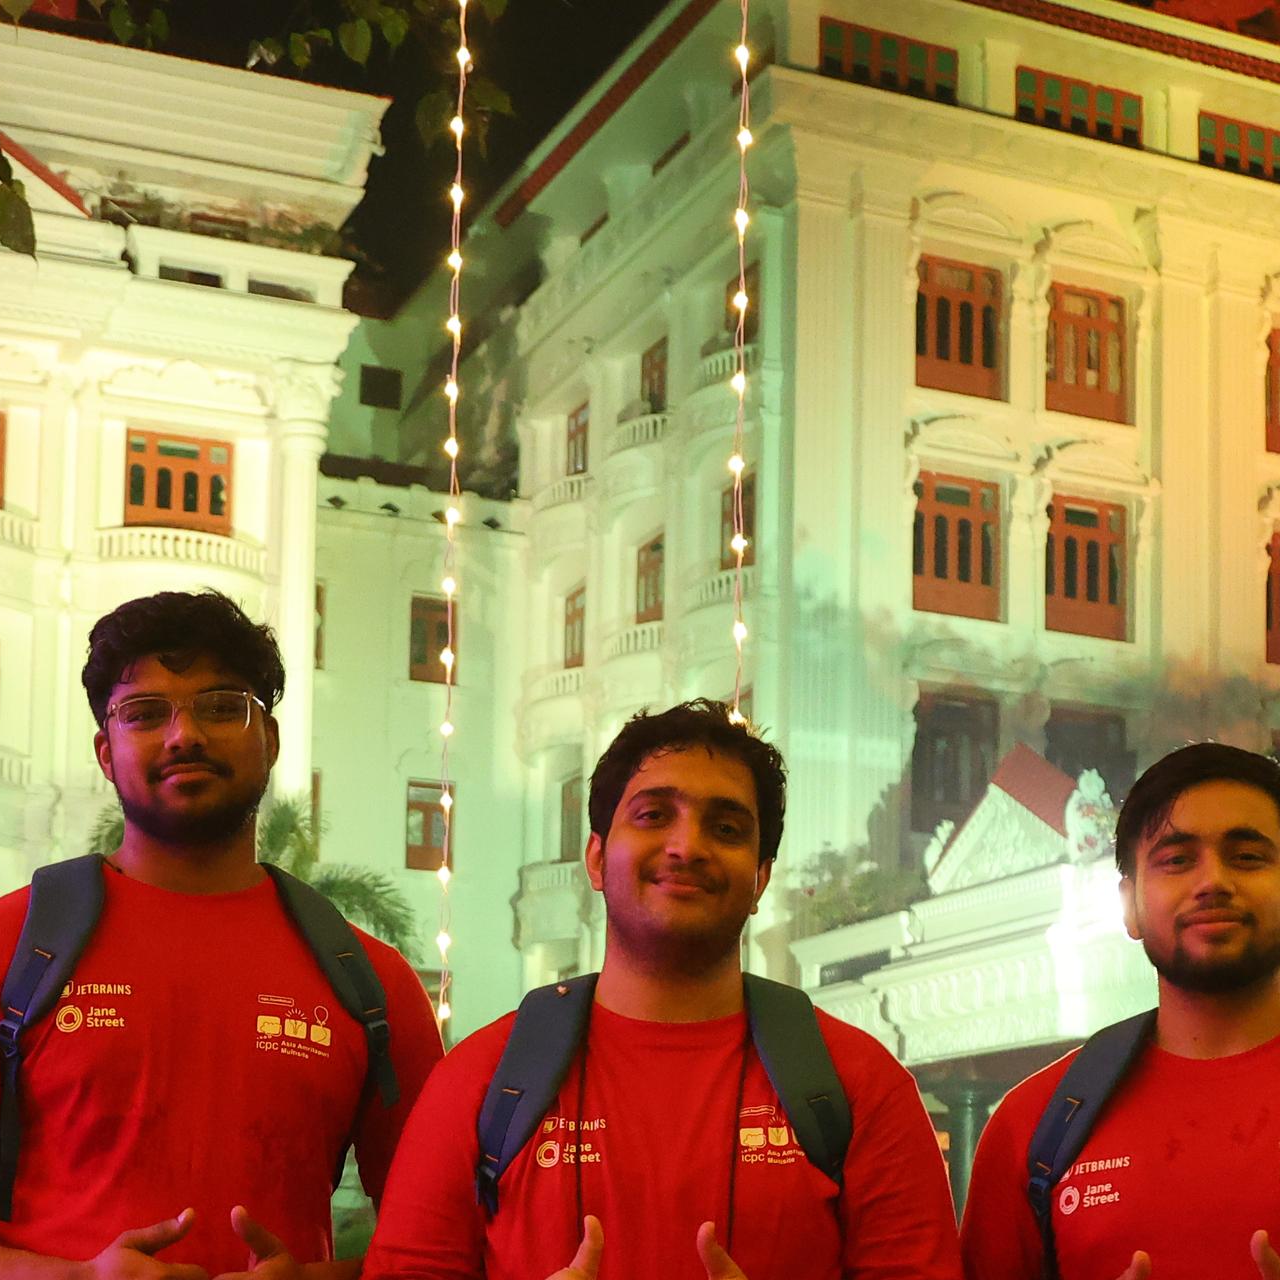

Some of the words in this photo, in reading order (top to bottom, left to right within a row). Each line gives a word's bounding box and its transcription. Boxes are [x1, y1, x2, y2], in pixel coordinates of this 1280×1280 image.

[76, 983, 132, 996] JETBRAINS
[86, 1006, 117, 1017] Jane
[86, 1016, 125, 1028] Street
[256, 1041, 279, 1051] icpc
[562, 1152, 601, 1164] Steet
[741, 1153, 765, 1164] icpc
[1074, 1156, 1131, 1175] JETBRAINS
[1083, 1183, 1113, 1196] Jane
[1082, 1191, 1120, 1208] Street
